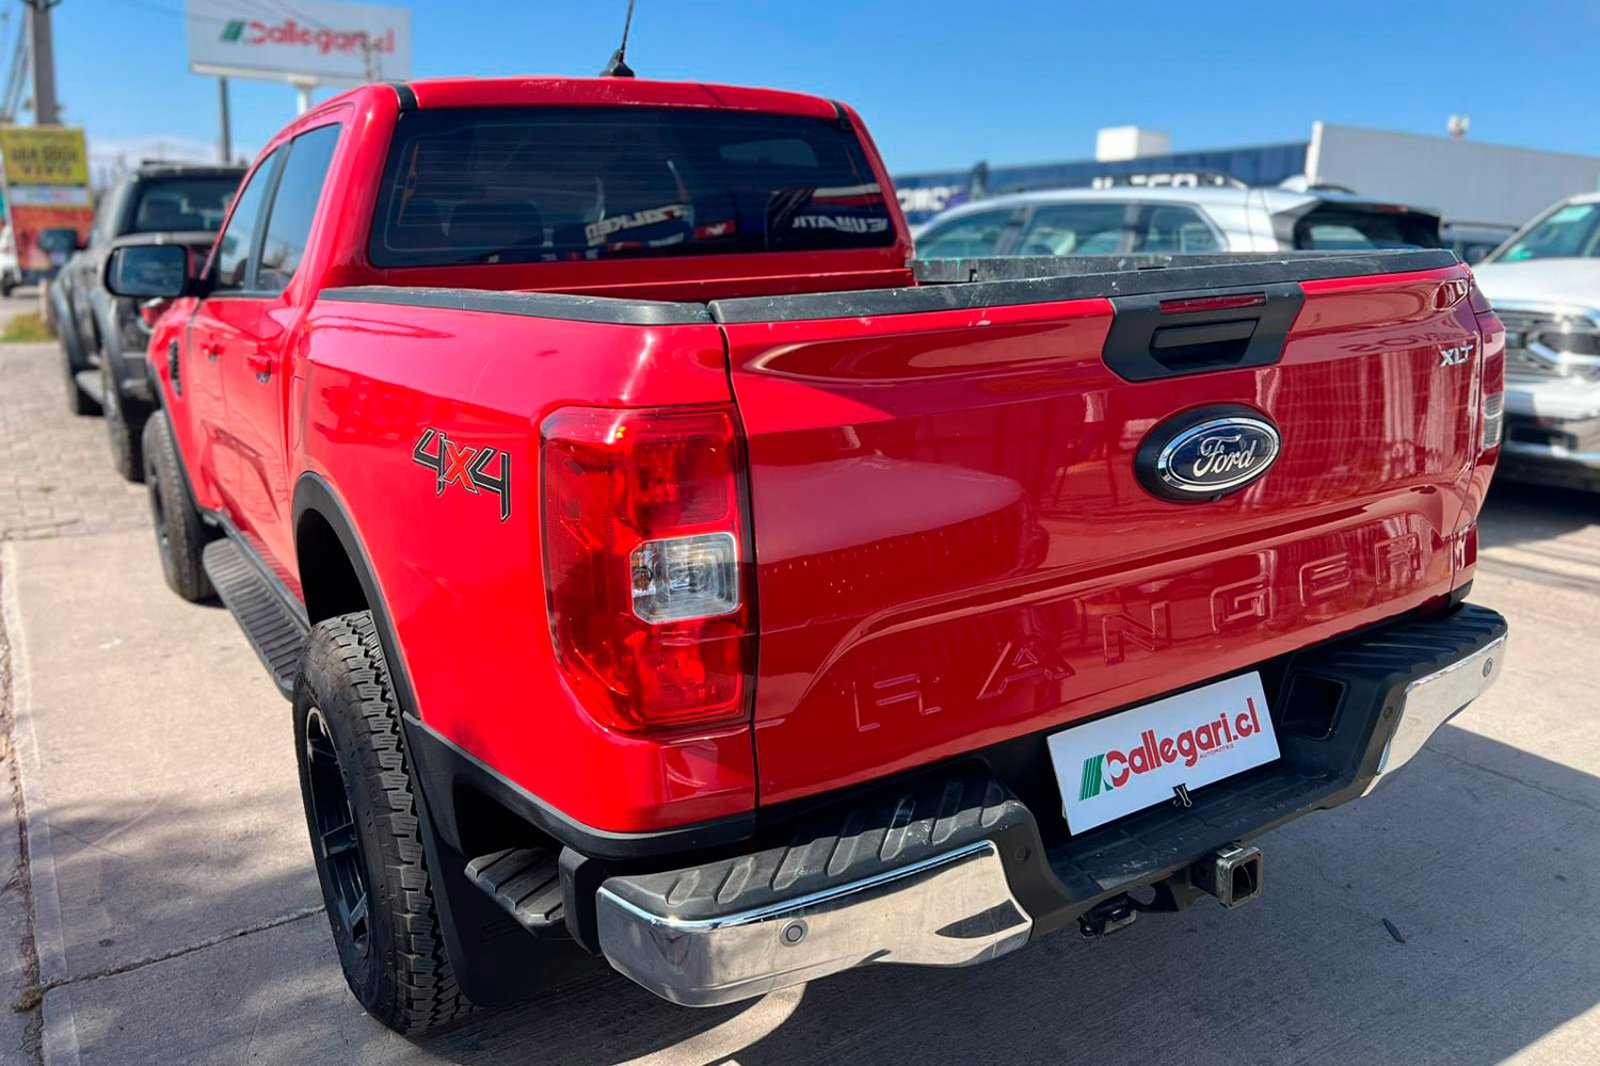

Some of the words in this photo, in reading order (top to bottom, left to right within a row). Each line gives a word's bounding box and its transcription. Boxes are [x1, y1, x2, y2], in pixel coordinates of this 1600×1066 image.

[1439, 343, 1474, 367] XLT
[1193, 434, 1258, 478] Ford
[853, 530, 1425, 733] RANGER
[1105, 696, 1261, 788] Callegari.cl
